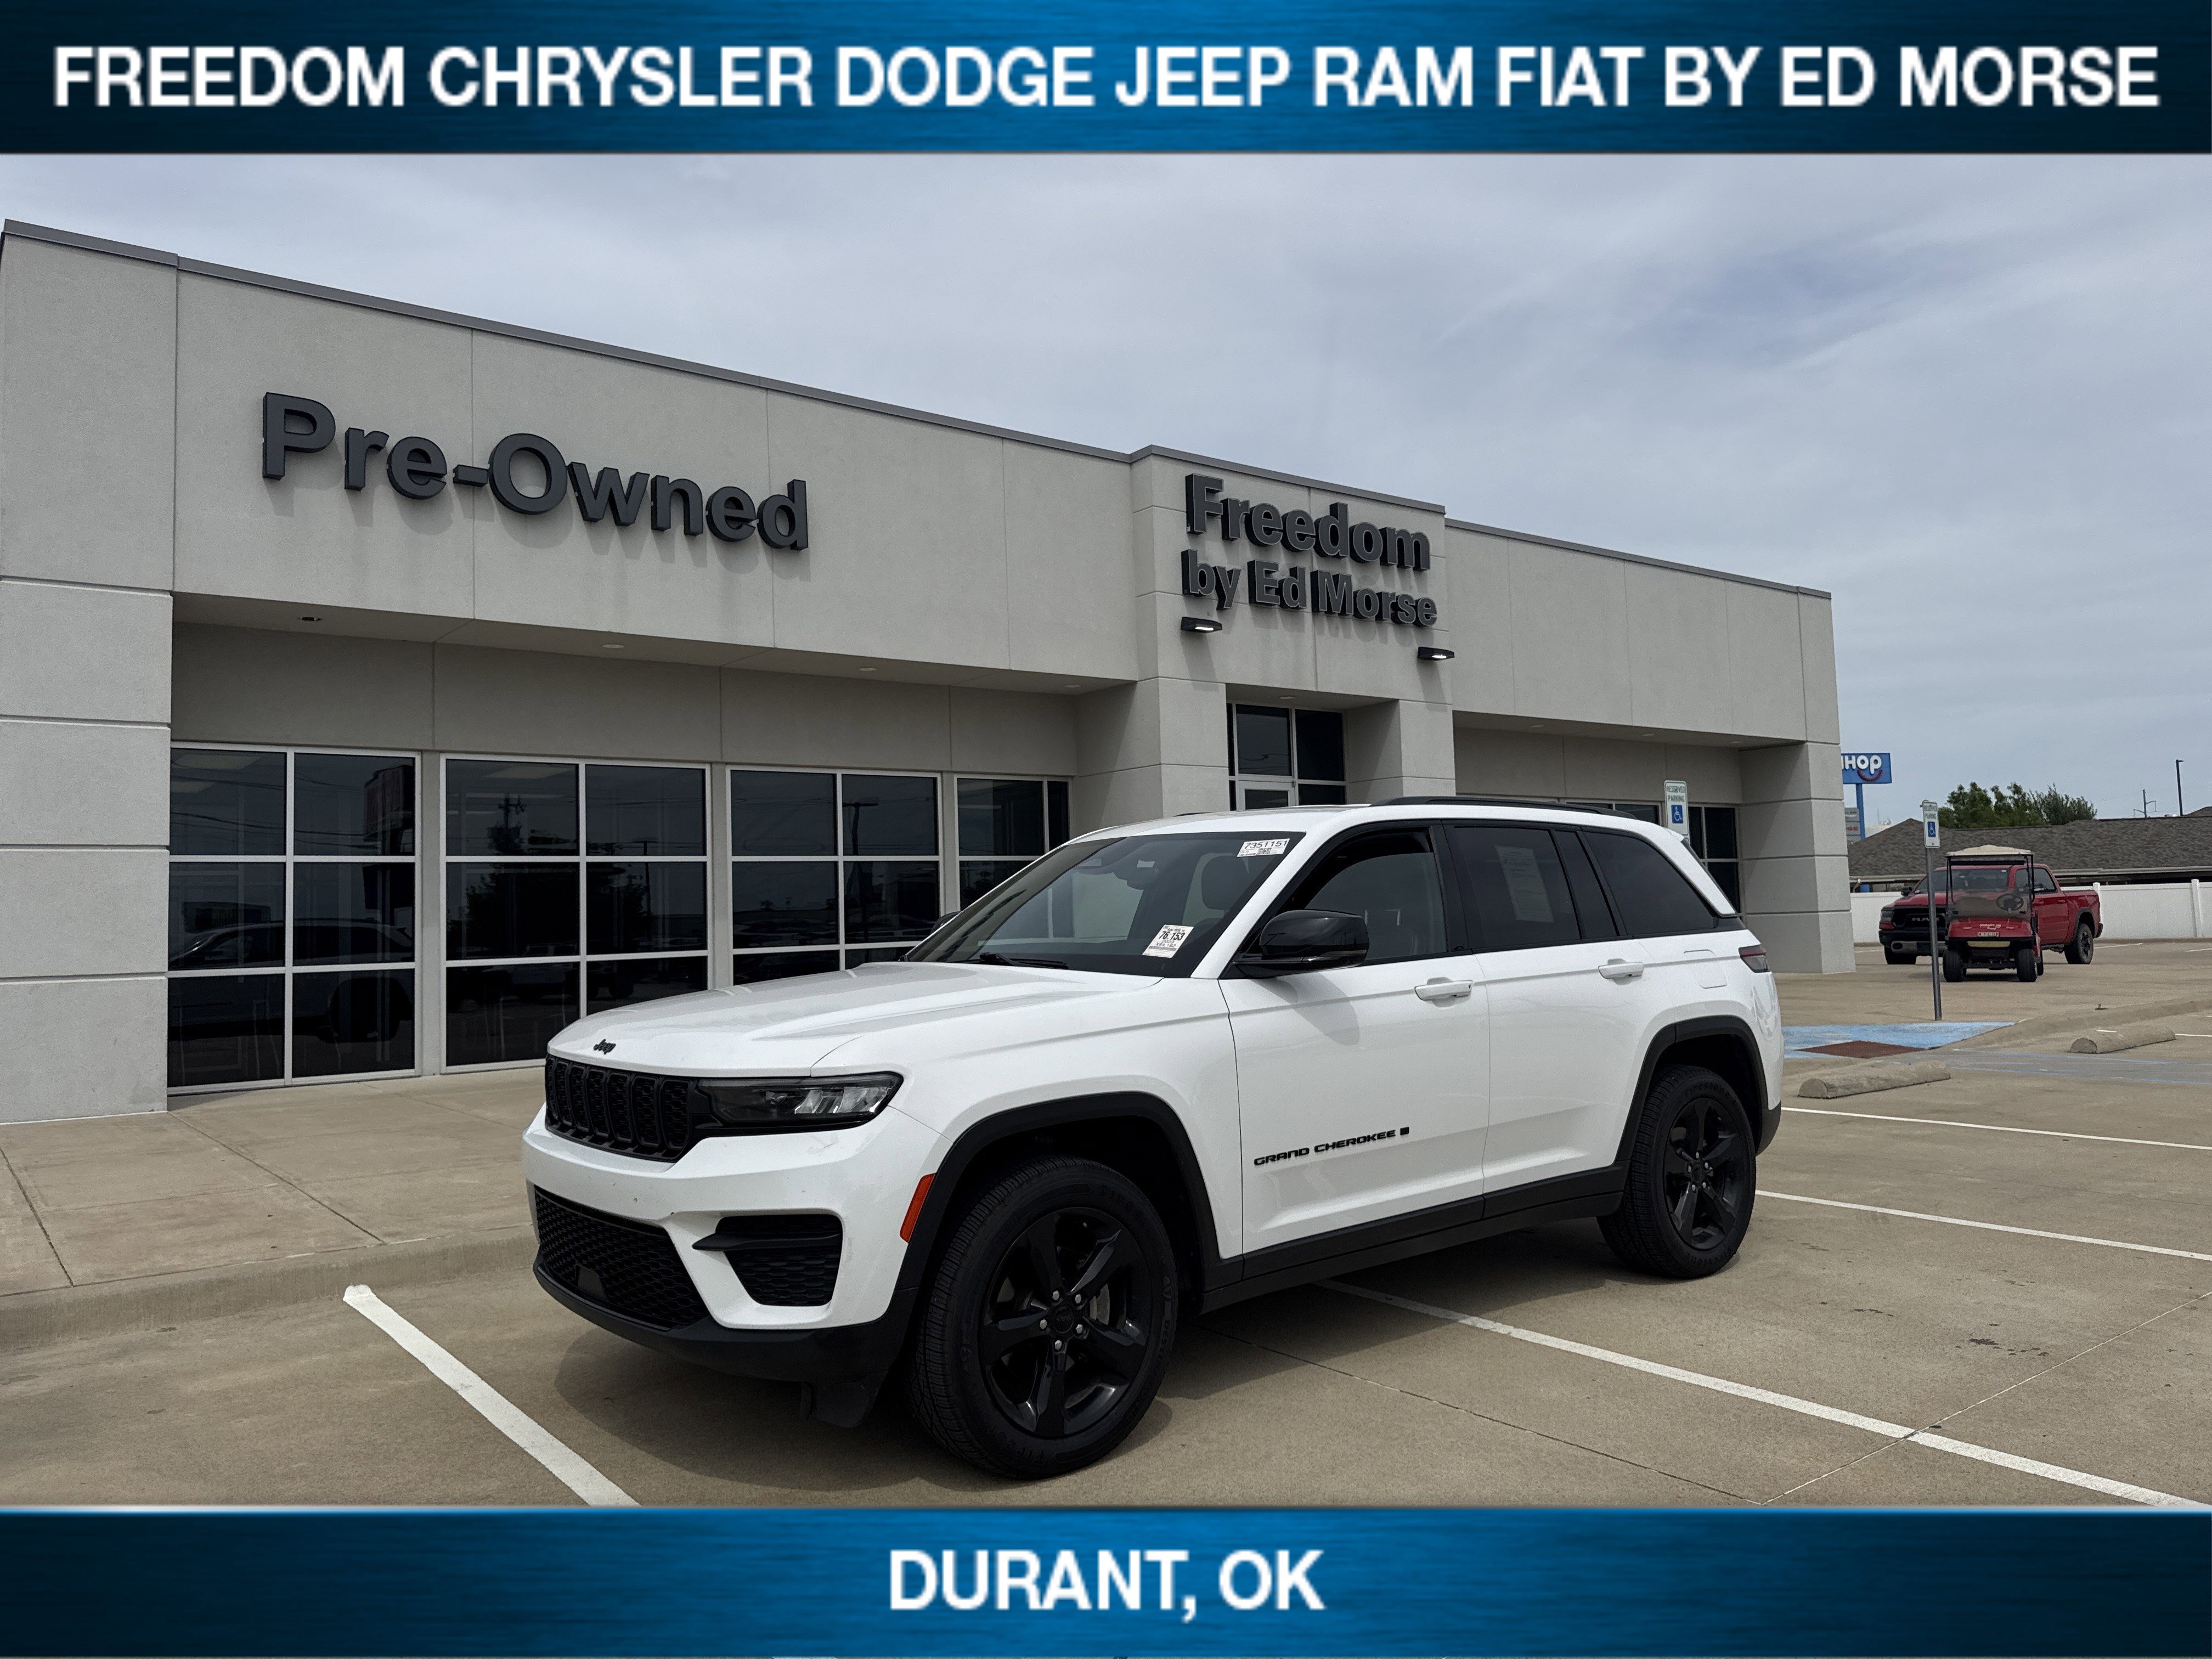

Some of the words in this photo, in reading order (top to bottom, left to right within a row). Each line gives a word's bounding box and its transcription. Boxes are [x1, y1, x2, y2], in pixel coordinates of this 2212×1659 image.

[263, 392, 808, 550] Pre-Owned
[1185, 473, 1430, 571] Freedom
[1181, 549, 1241, 611] by
[1247, 559, 1307, 610] Ed
[1310, 569, 1437, 628] Morse
[1244, 840, 1288, 849] 7351151
[593, 1039, 616, 1055] Jeep
[1254, 1147, 1310, 1166] GRAND
[1314, 1130, 1396, 1153] CHEROKEE
